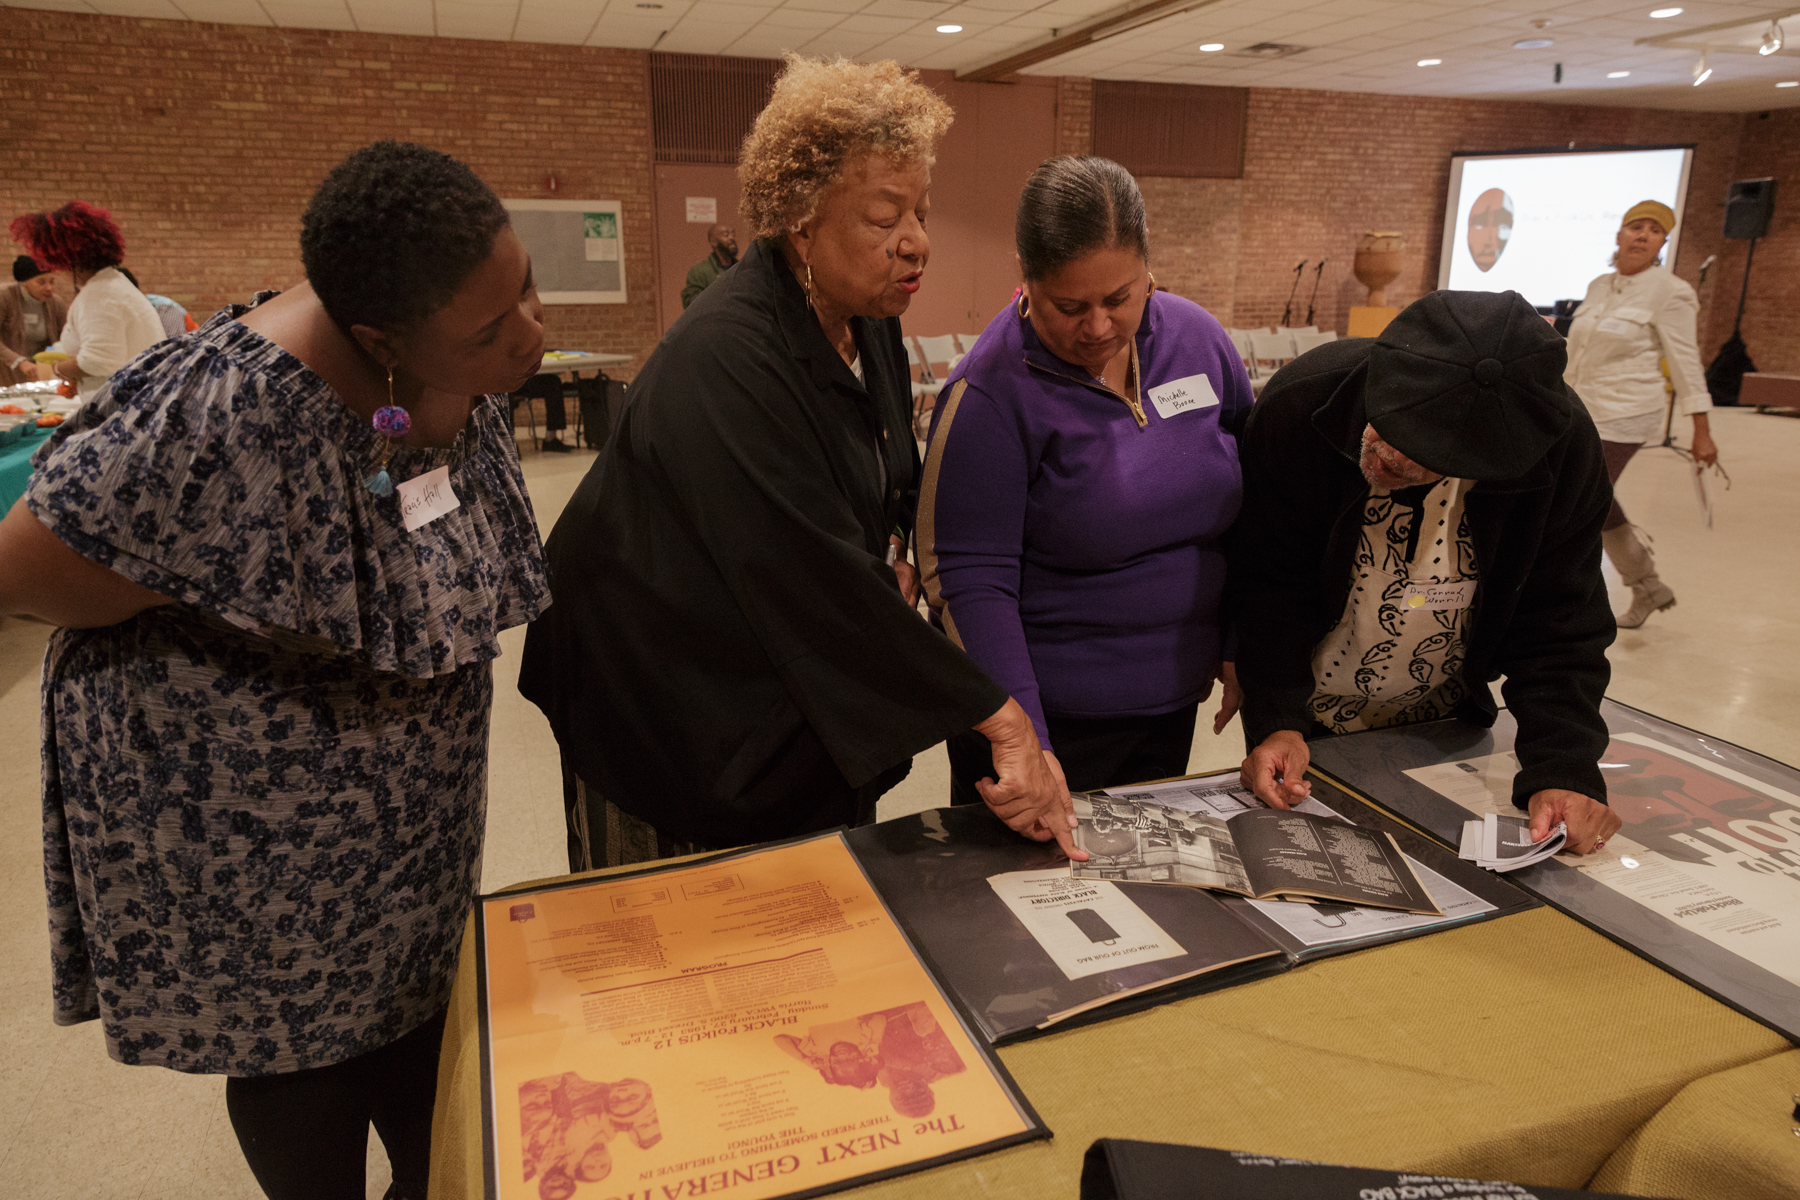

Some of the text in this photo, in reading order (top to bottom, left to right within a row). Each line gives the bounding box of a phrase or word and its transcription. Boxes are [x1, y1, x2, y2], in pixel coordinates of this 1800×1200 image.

[1157, 388, 1188, 405] Michelle
[1172, 398, 1195, 410] Boone
[423, 483, 442, 507] Hall
[1030, 889, 1098, 905] BLACK DIRECTORY
[1122, 947, 1138, 955] OUT
[1137, 943, 1159, 952] FROM
[681, 961, 728, 974] PROGRAM
[1076, 956, 1093, 964] BAG
[744, 1005, 776, 1016] YWCA
[787, 1002, 829, 1014] Sunday
[729, 1010, 776, 1025] February
[653, 1015, 798, 1050] BLACK FolkUS 12
[681, 1025, 707, 1036] 1983
[914, 1114, 966, 1137] The
[727, 1126, 806, 1150] THE YOUNG!
[638, 1114, 892, 1181] THEY NEED SOMETHING TO BELIEVE IN
[816, 1128, 903, 1166] NEXT
[1359, 1186, 1398, 1200] BAG
[1394, 1183, 1445, 1199] BLACK
